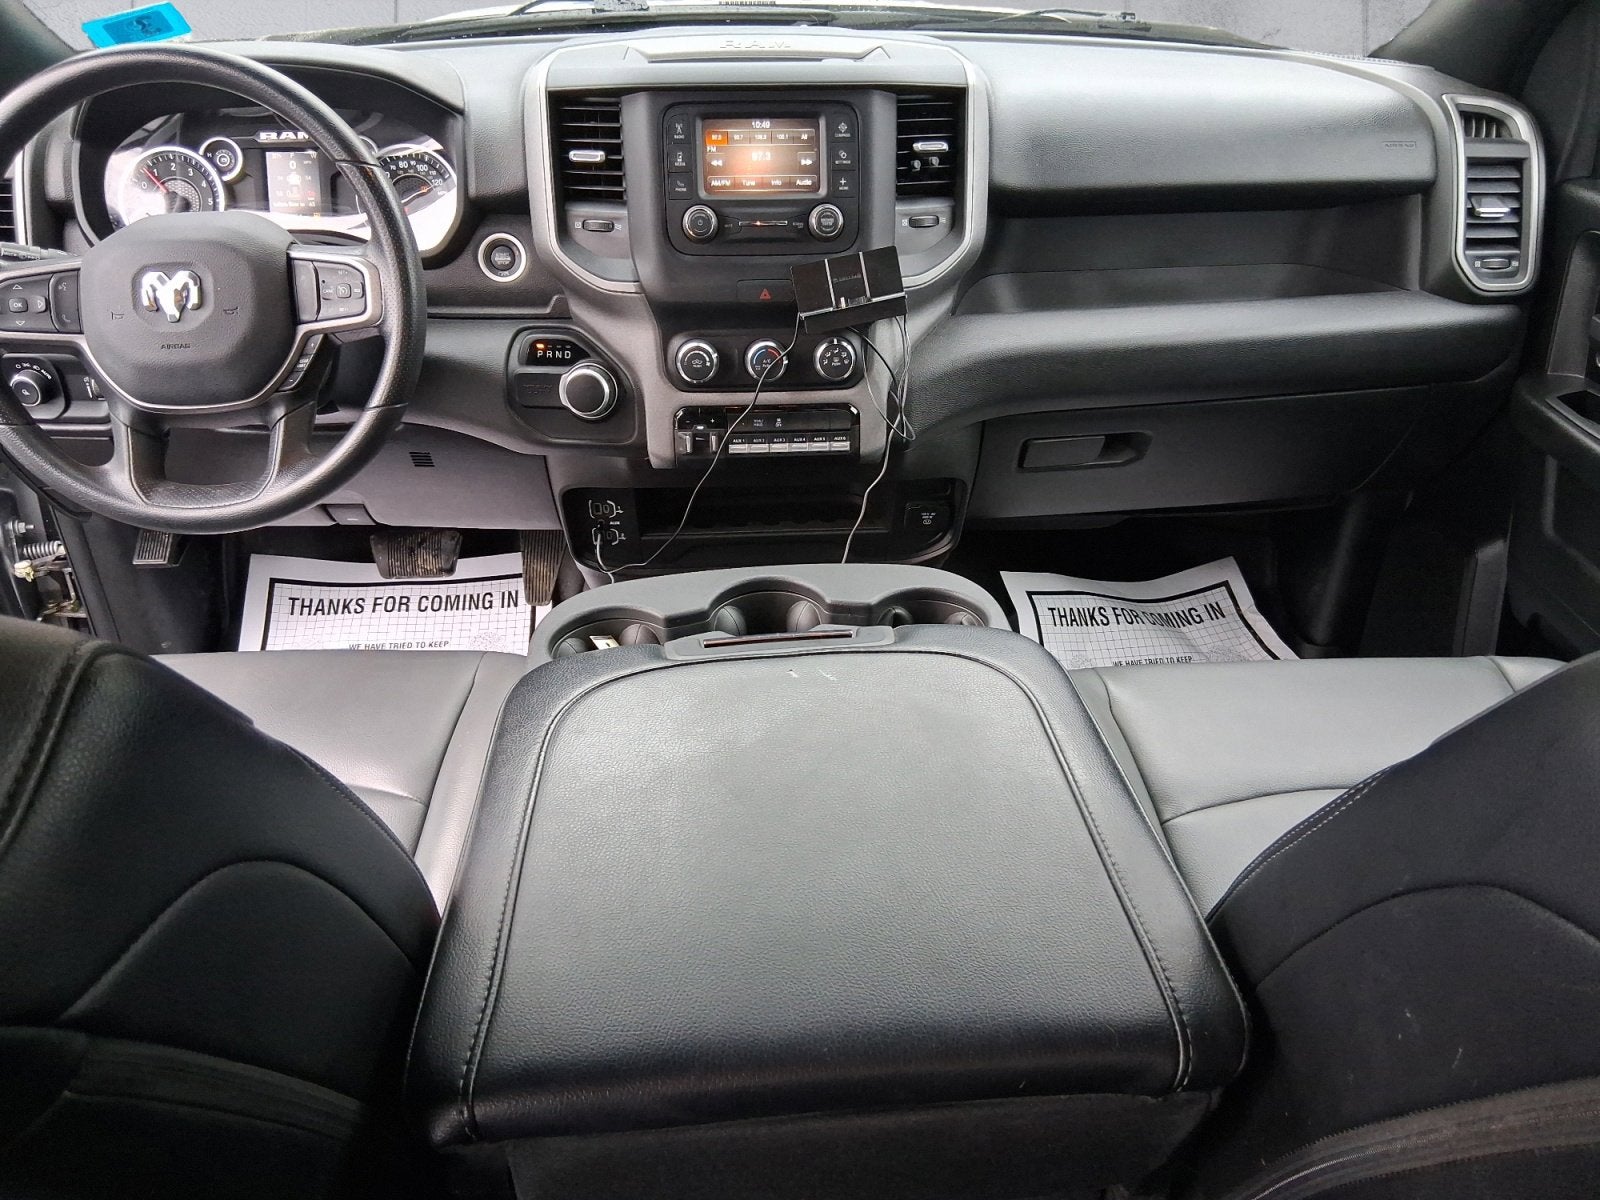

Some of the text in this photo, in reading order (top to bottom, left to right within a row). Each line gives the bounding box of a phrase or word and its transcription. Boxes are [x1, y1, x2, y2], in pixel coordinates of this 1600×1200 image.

[752, 121, 770, 129] 10:49
[170, 162, 177, 171] 2
[399, 160, 408, 168] 80
[153, 168, 159, 177] 1
[188, 168, 194, 177] 3
[141, 181, 148, 190] 0
[201, 180, 207, 188] 4
[208, 196, 214, 206] 5
[288, 590, 519, 616] THANKS FOR COMING IN
[1047, 602, 1226, 629] THANKS FOR COMING IN
[388, 641, 412, 649] TRIED
[428, 640, 449, 648] KEEP
[1176, 655, 1193, 663] KEEP
